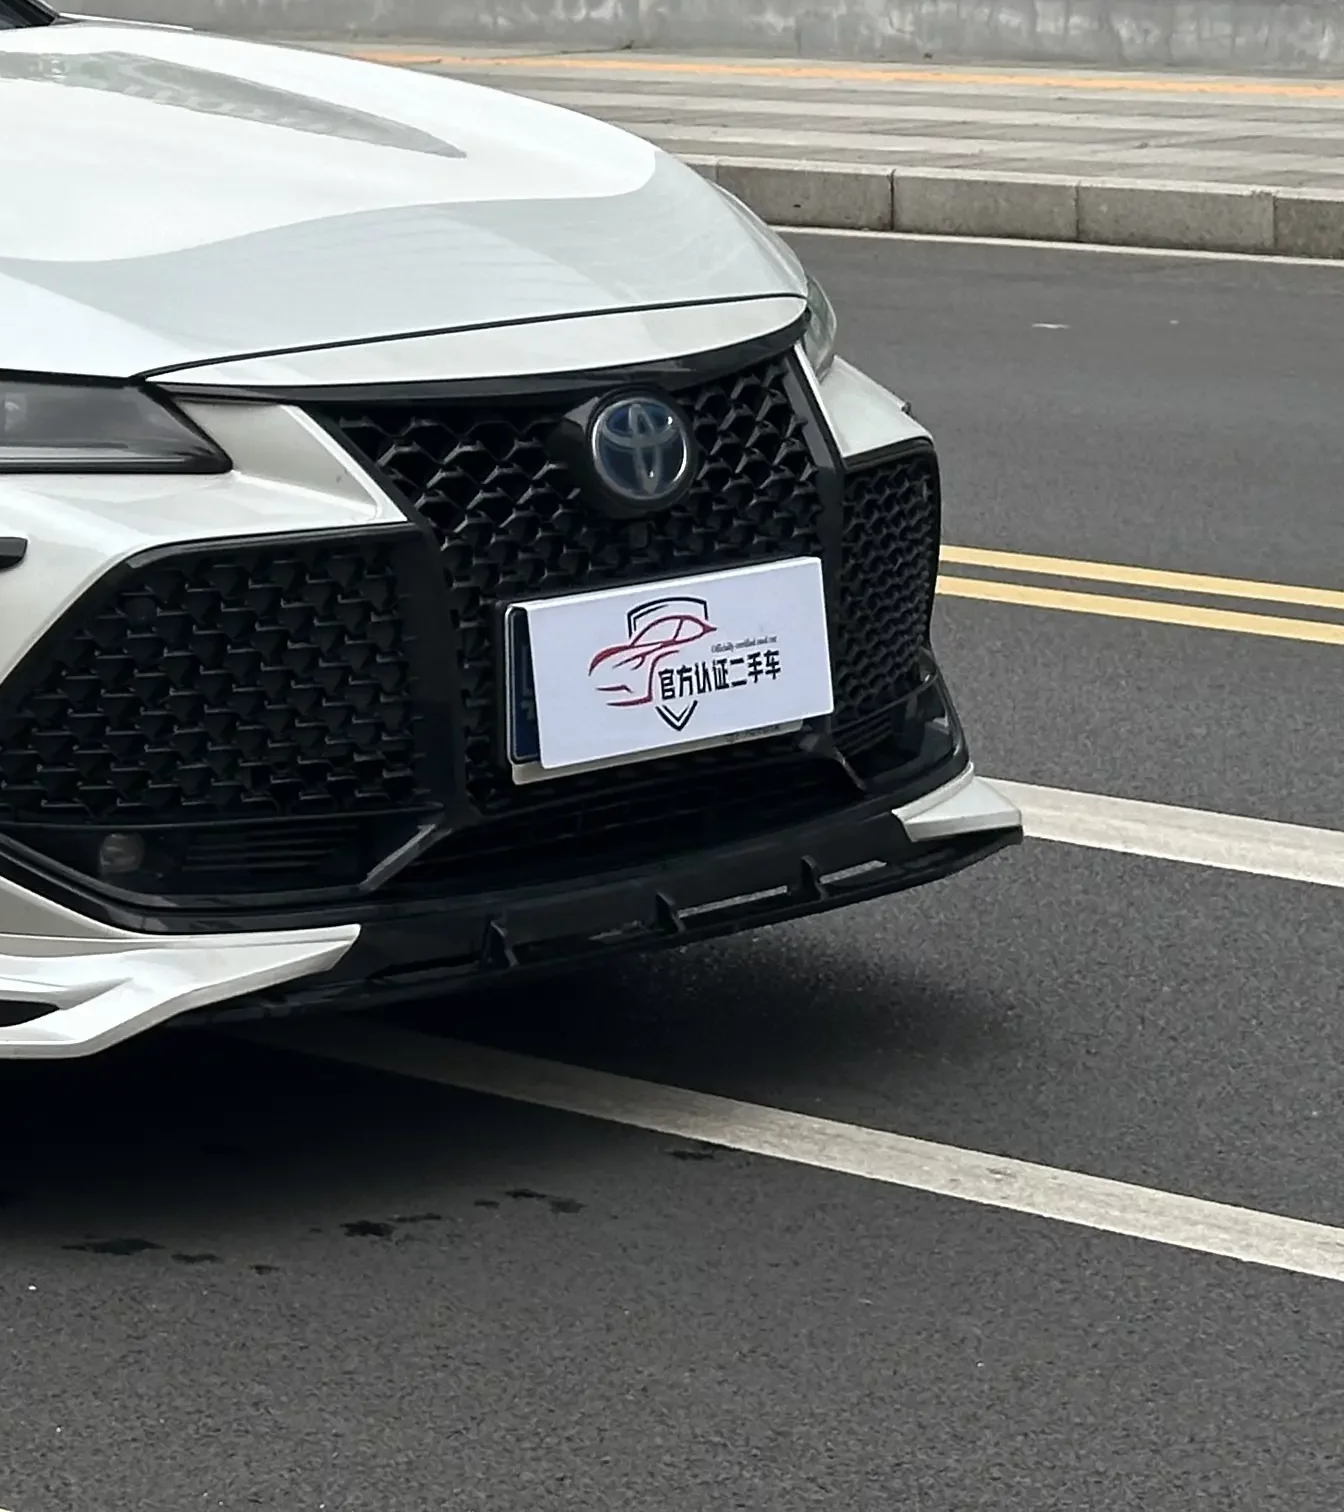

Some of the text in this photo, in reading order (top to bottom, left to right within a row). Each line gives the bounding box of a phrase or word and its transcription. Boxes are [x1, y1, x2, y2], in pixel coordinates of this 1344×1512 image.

[658, 649, 781, 701] 官方认证二手车
